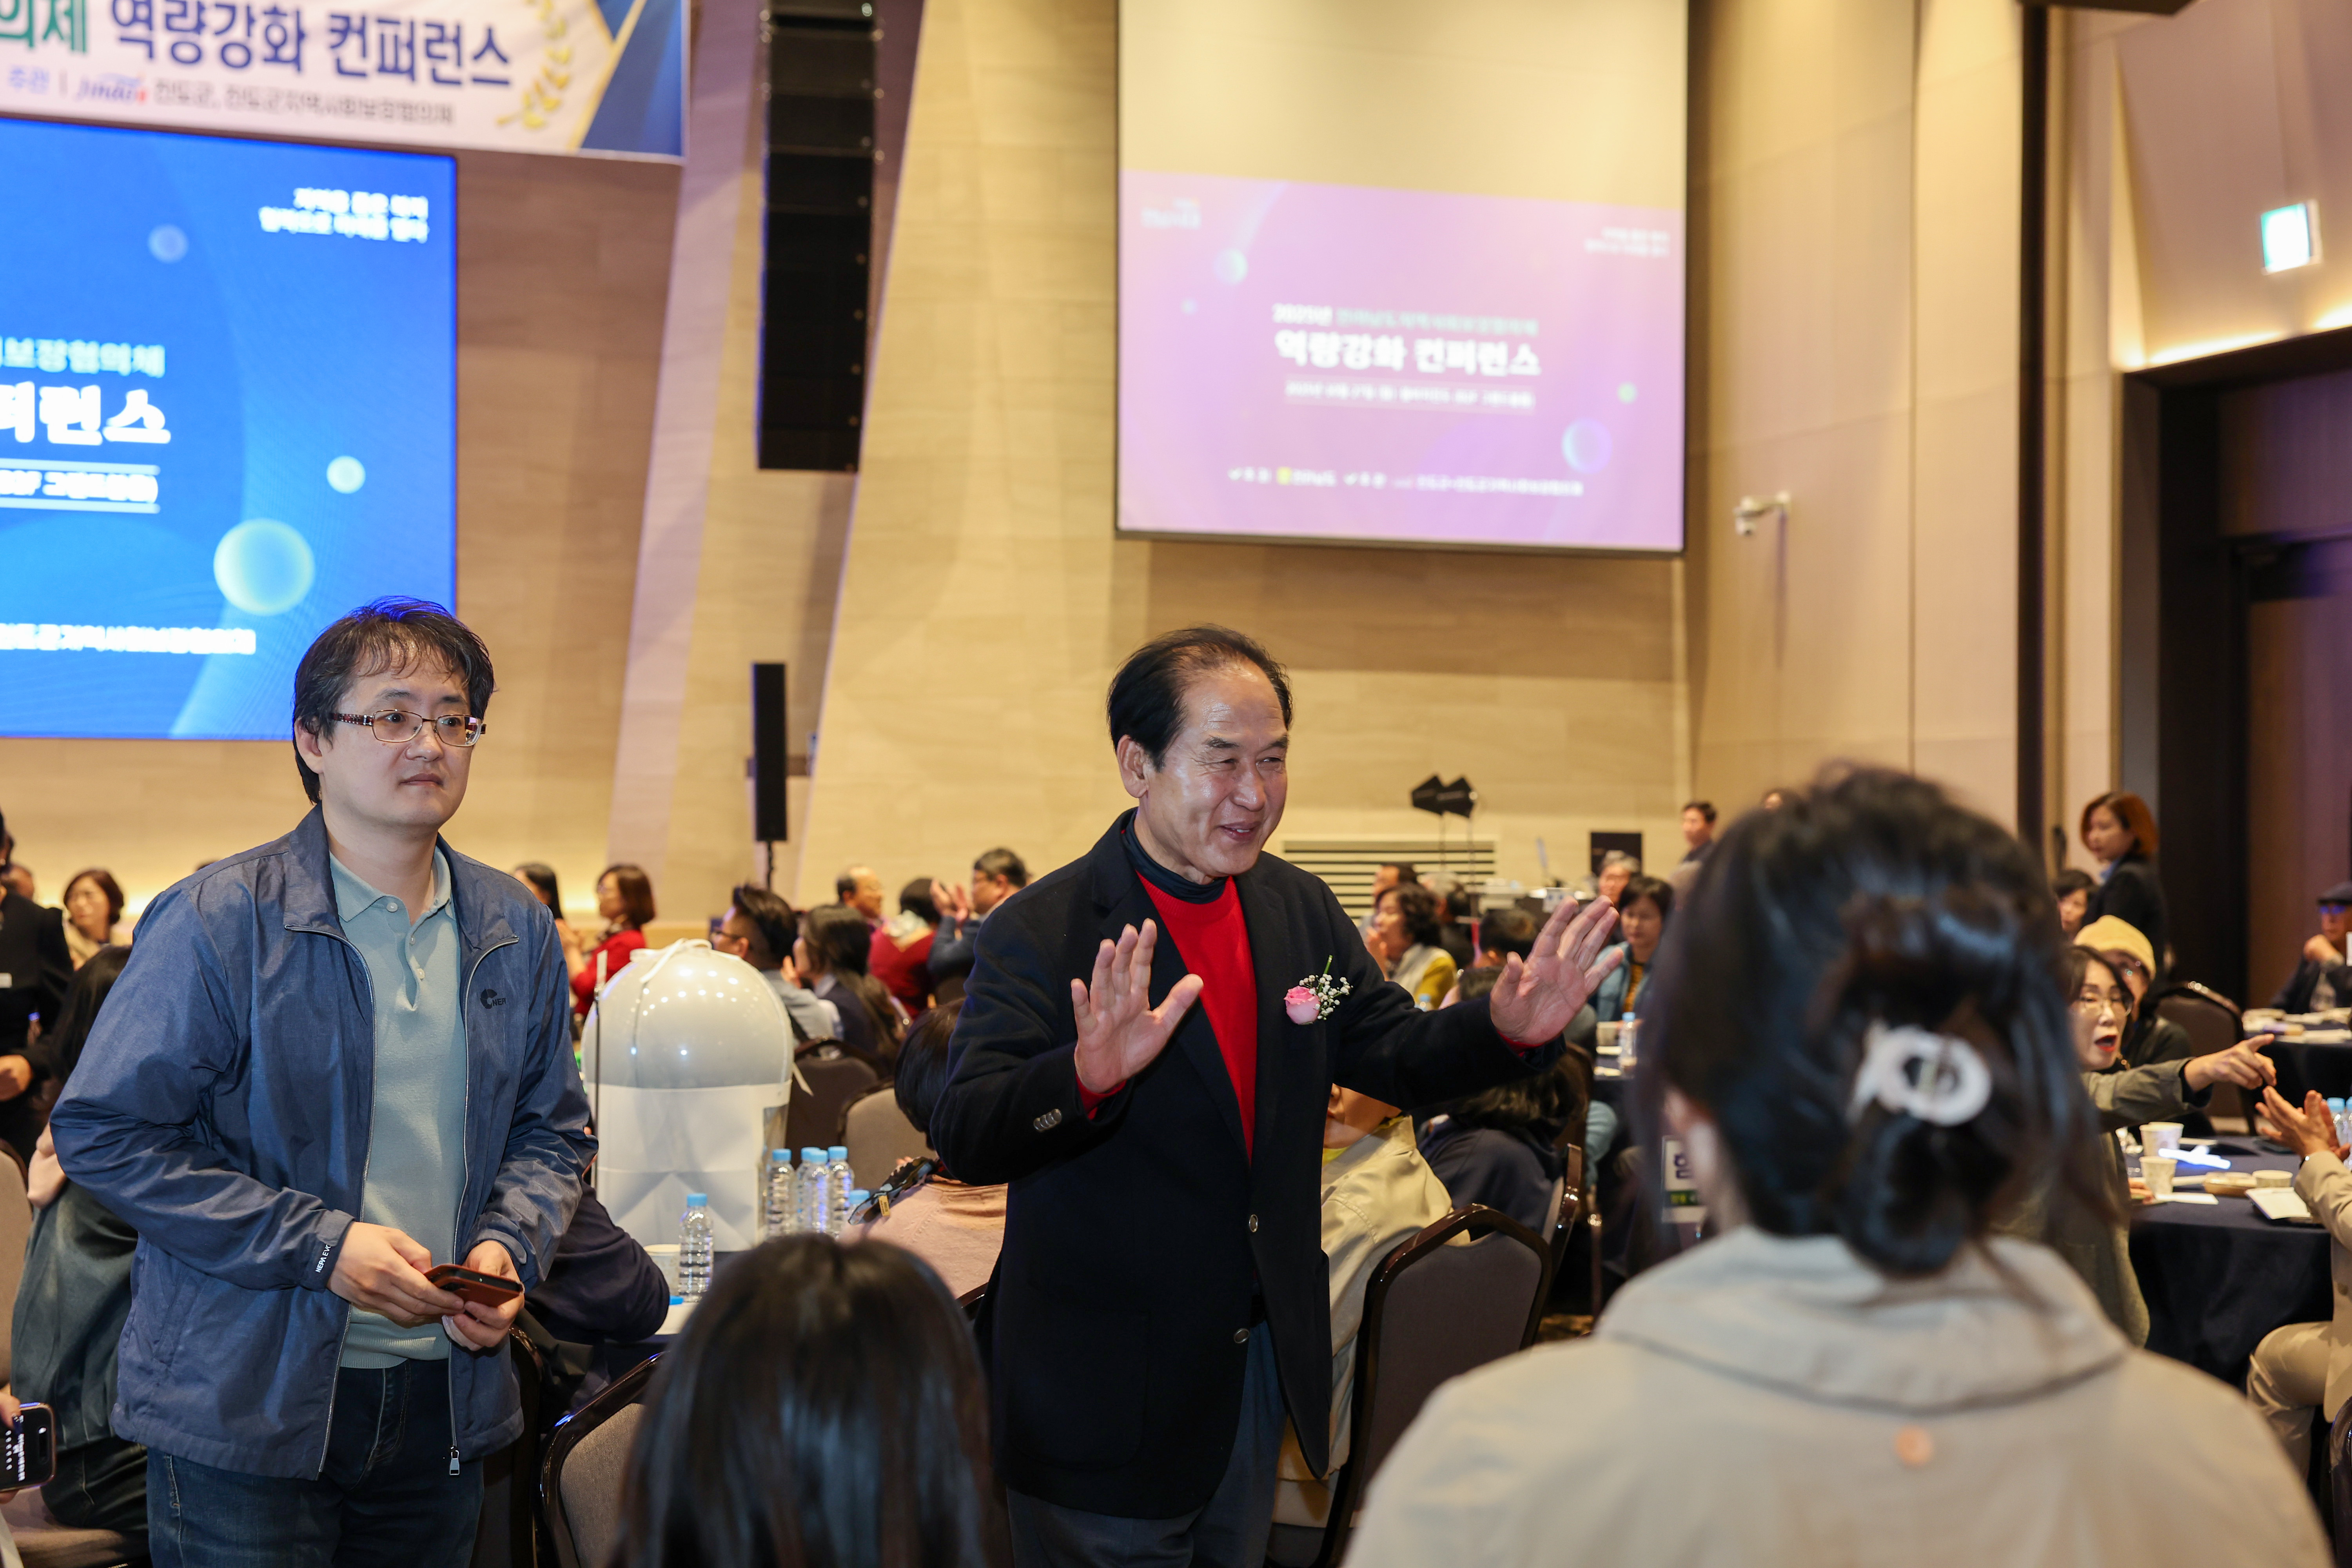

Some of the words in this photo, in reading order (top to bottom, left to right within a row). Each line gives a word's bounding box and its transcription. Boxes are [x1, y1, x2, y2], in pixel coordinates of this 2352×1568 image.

[113, 0, 307, 73] 역량강화
[327, 12, 511, 88] 컨퍼런스
[1274, 329, 1408, 371] 역량강화
[1414, 337, 1542, 377] 컨퍼런스
[315, 1257, 327, 1273] NEPA
